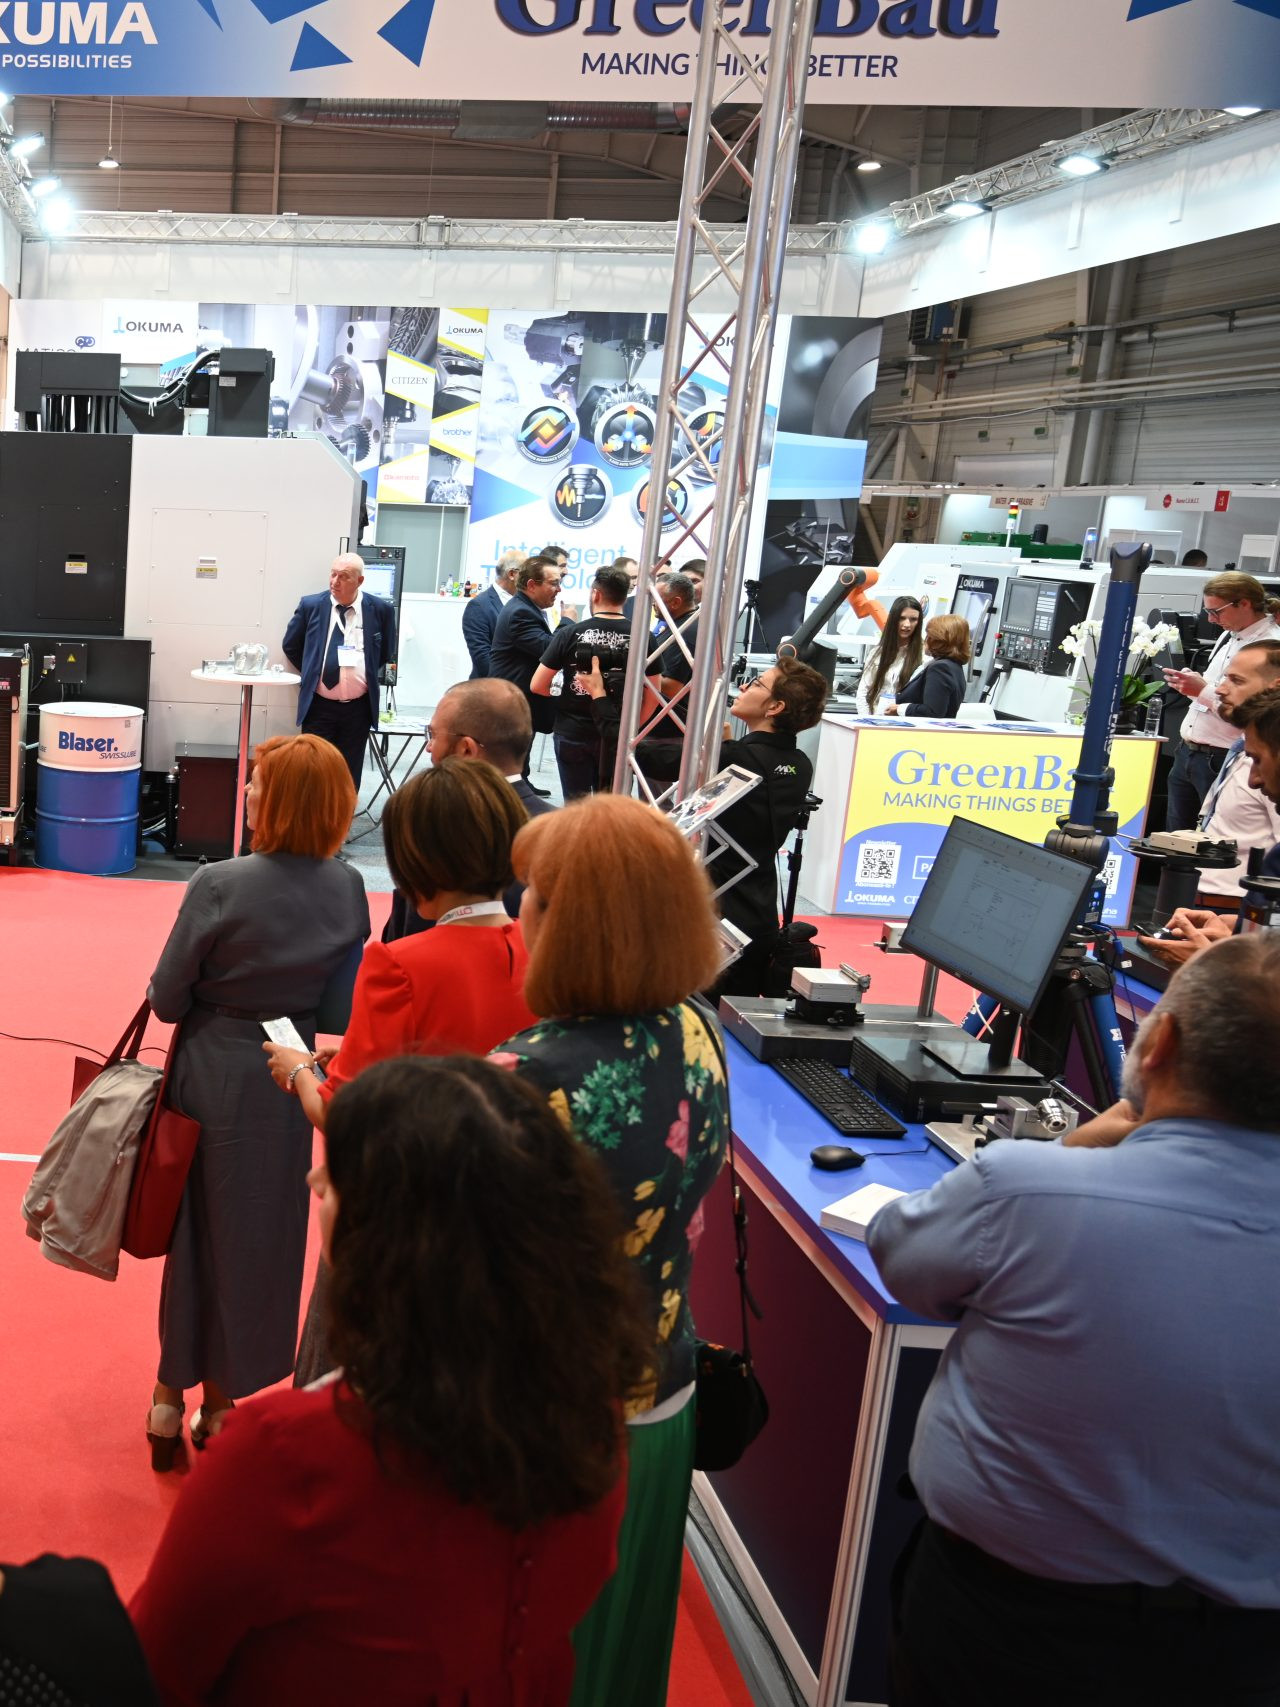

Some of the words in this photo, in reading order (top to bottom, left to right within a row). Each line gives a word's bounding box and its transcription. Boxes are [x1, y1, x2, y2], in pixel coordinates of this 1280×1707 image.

[1, 53, 133, 69] POSSIBILITIES
[581, 52, 690, 76] MAKING
[126, 321, 183, 333] OKUMA
[391, 376, 428, 385] CITIZEN
[442, 428, 472, 436] brother
[963, 579, 985, 589] OKUMA
[887, 749, 1080, 792] GreenBa
[883, 791, 962, 809] MAKING
[966, 795, 1037, 813] THINGS
[1040, 798, 1075, 815] BET
[853, 893, 896, 903] OKUMA
